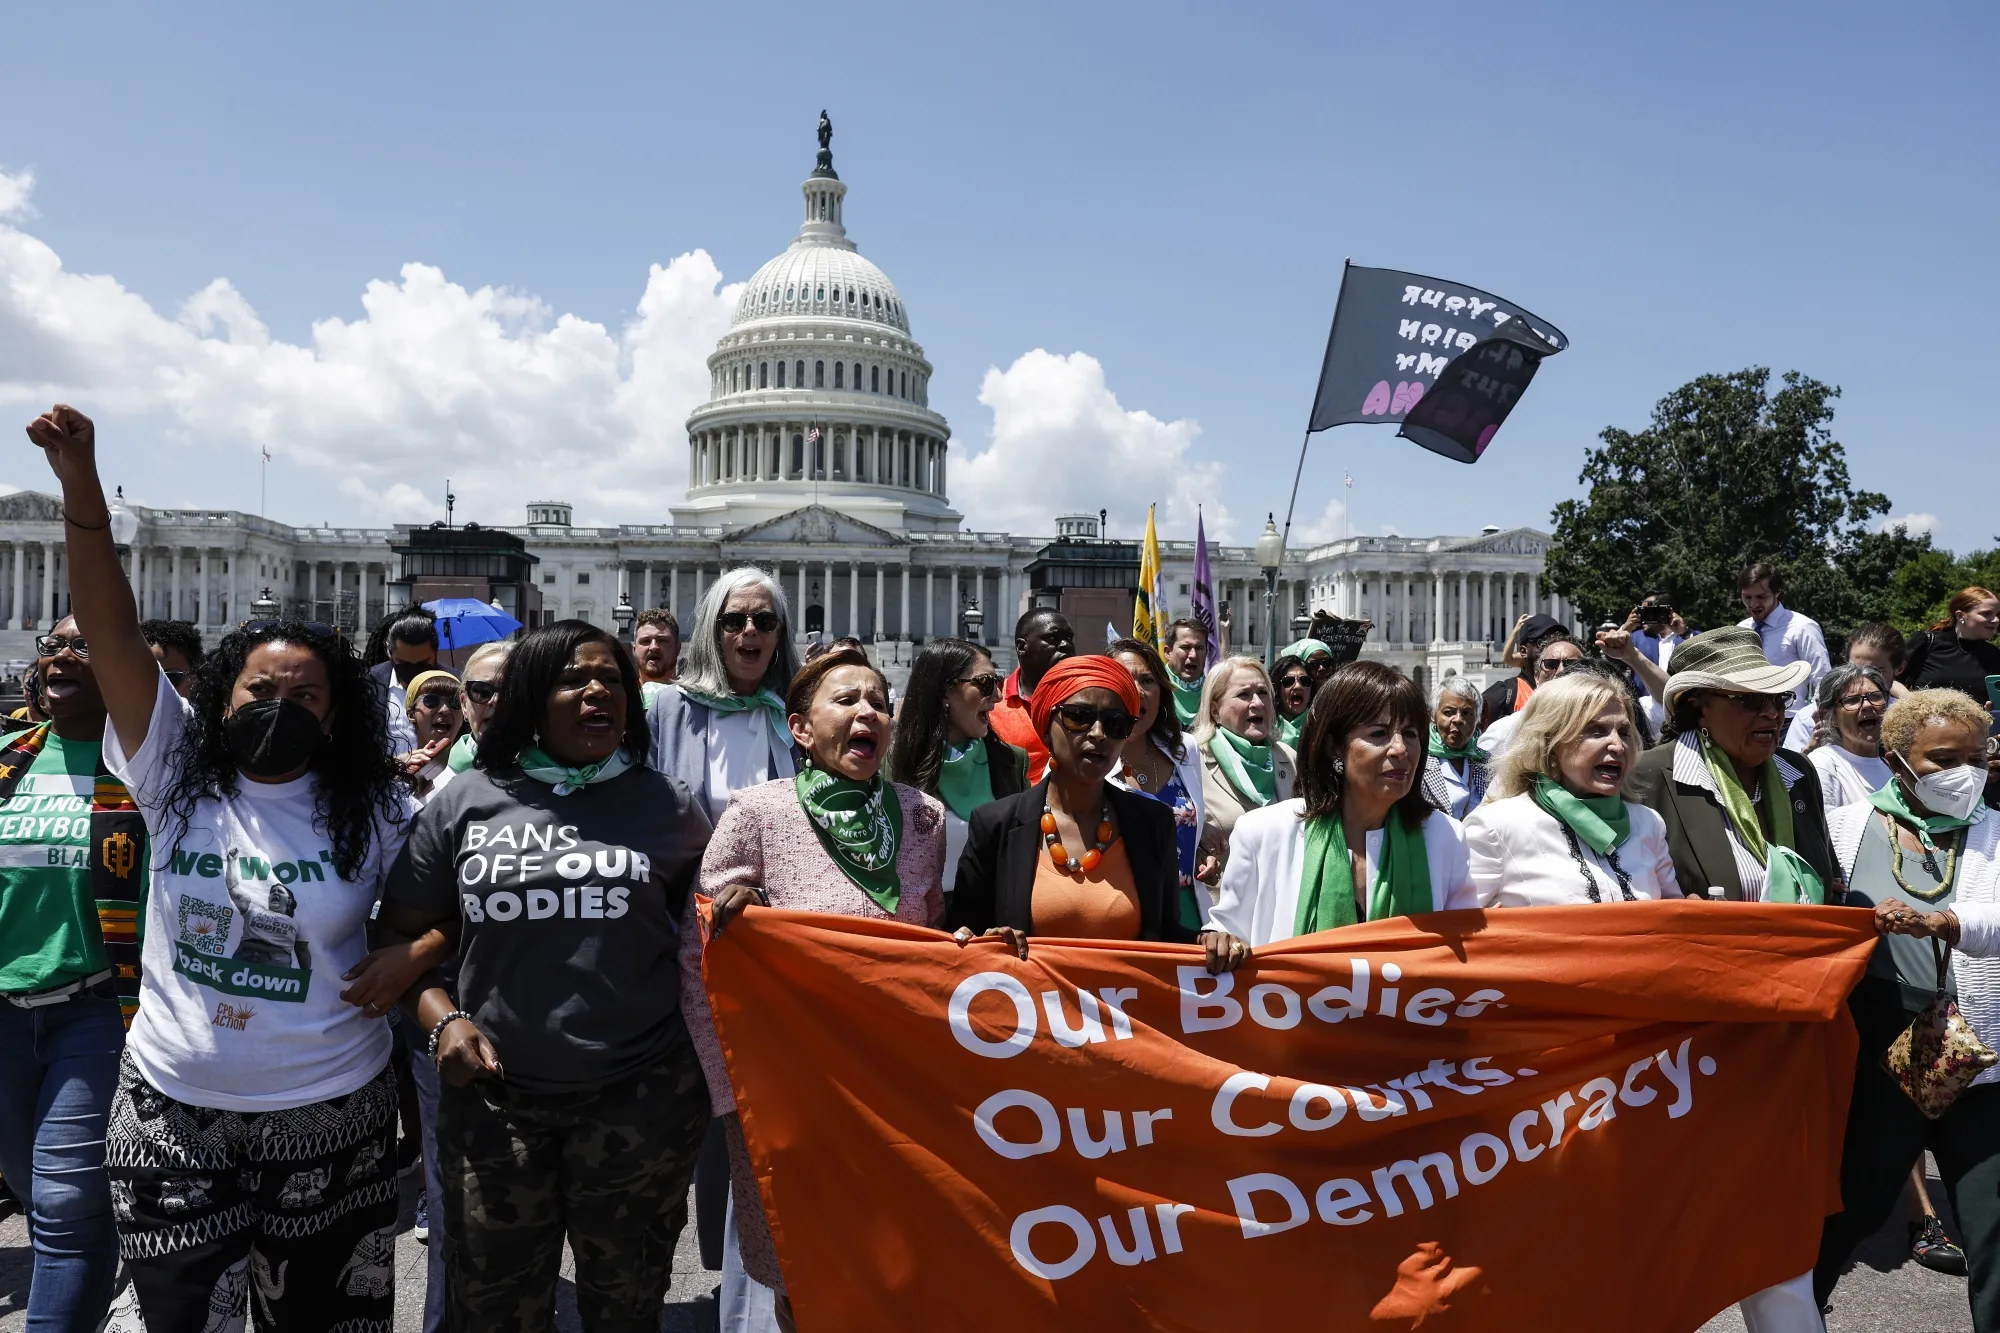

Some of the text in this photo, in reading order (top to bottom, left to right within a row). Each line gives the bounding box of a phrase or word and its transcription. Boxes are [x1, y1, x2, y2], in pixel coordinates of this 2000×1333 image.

[465, 823, 579, 852] BANS
[838, 827, 868, 838] PUERTO
[47, 848, 92, 867] BLA
[461, 849, 651, 886] OFF OUR
[462, 886, 631, 923] BODIES
[178, 947, 301, 994] back down
[212, 1015, 247, 1032] ACTION
[948, 971, 1139, 1059] Our
[973, 1055, 1539, 1160] Our Courts.
[1009, 1036, 1717, 1281] Our Democracy.
